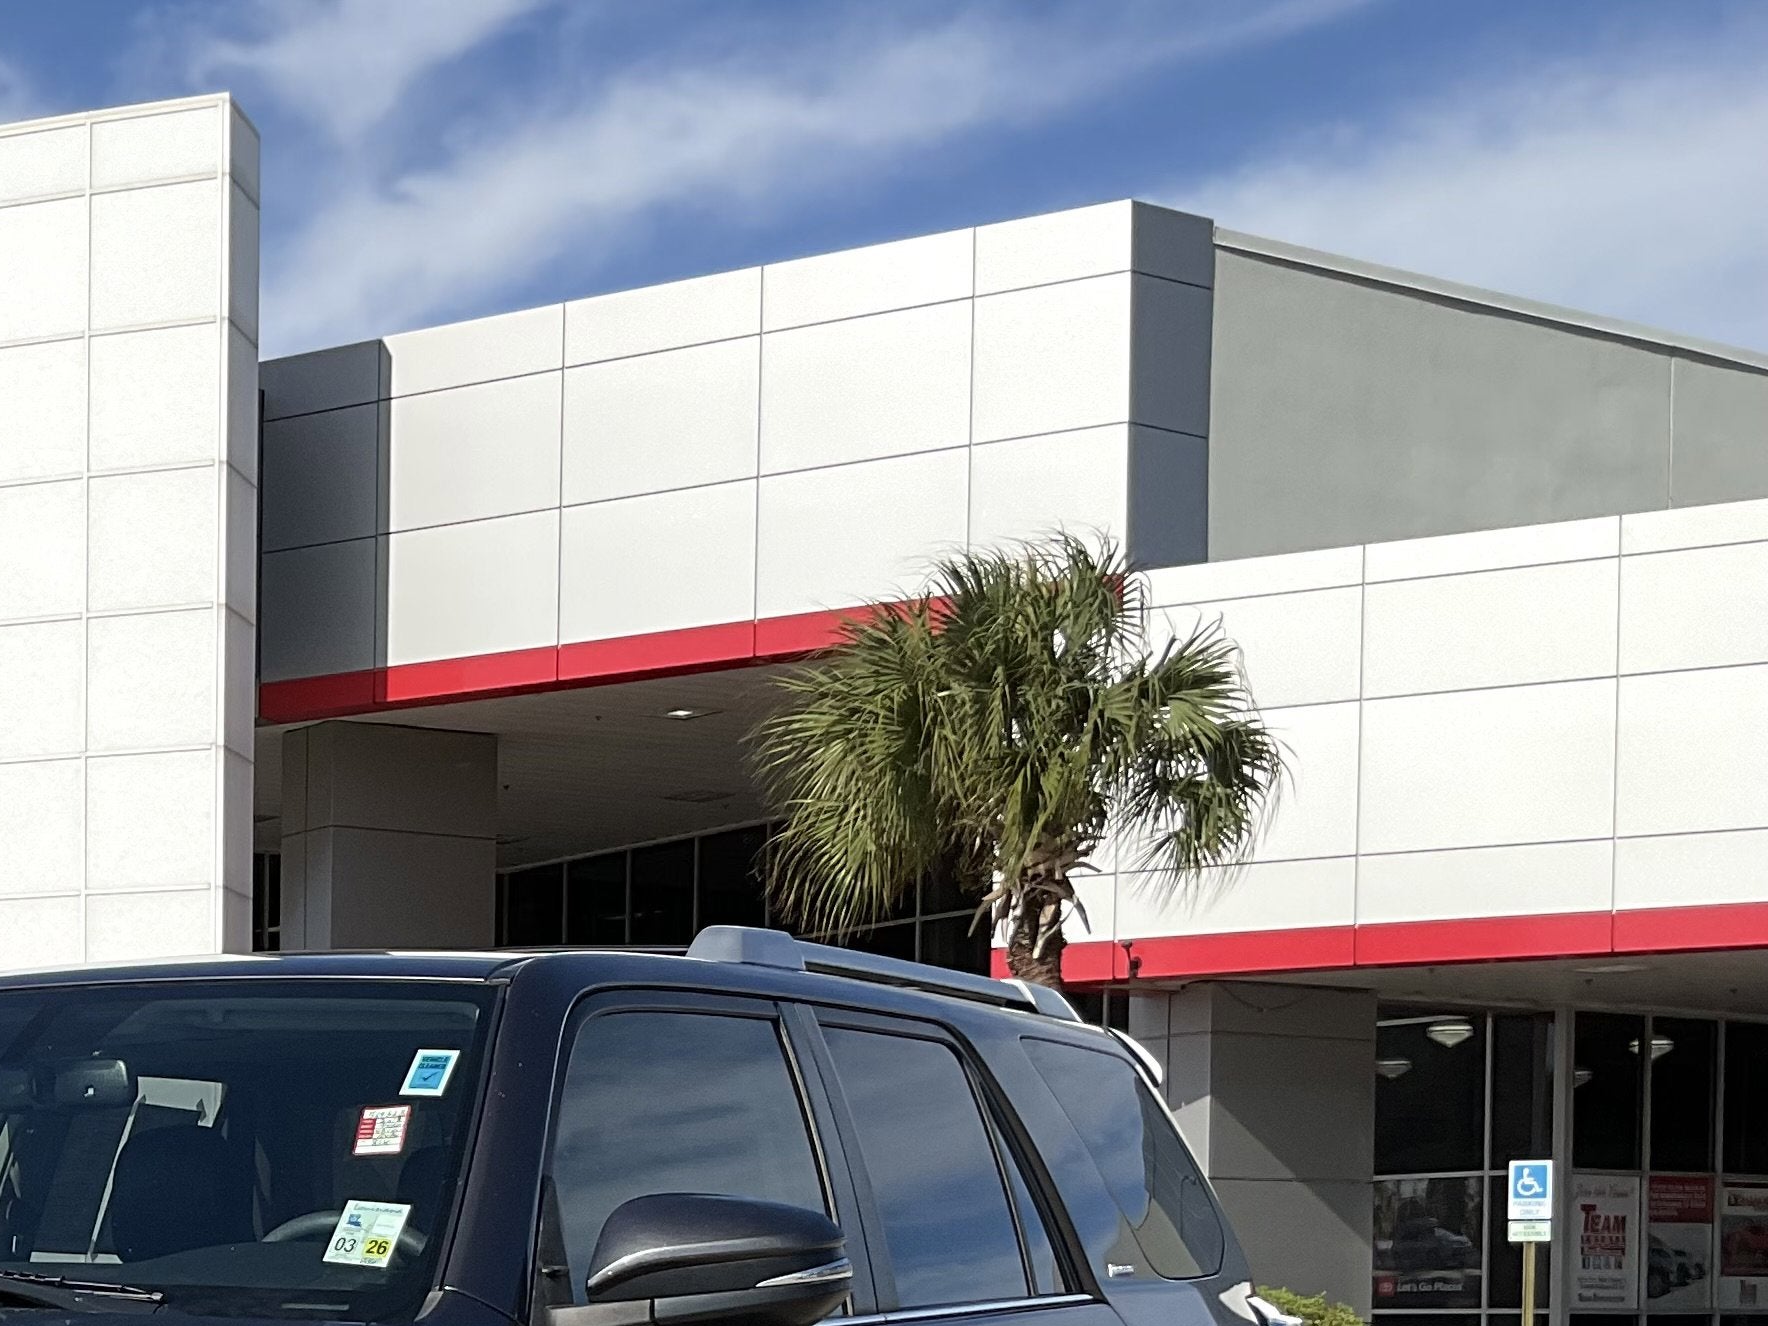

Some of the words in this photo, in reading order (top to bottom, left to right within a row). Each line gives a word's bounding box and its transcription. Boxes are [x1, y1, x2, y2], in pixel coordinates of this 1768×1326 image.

[1580, 1203, 1627, 1233] TEAM
[334, 1237, 357, 1253] 03
[365, 1239, 389, 1255] 26
